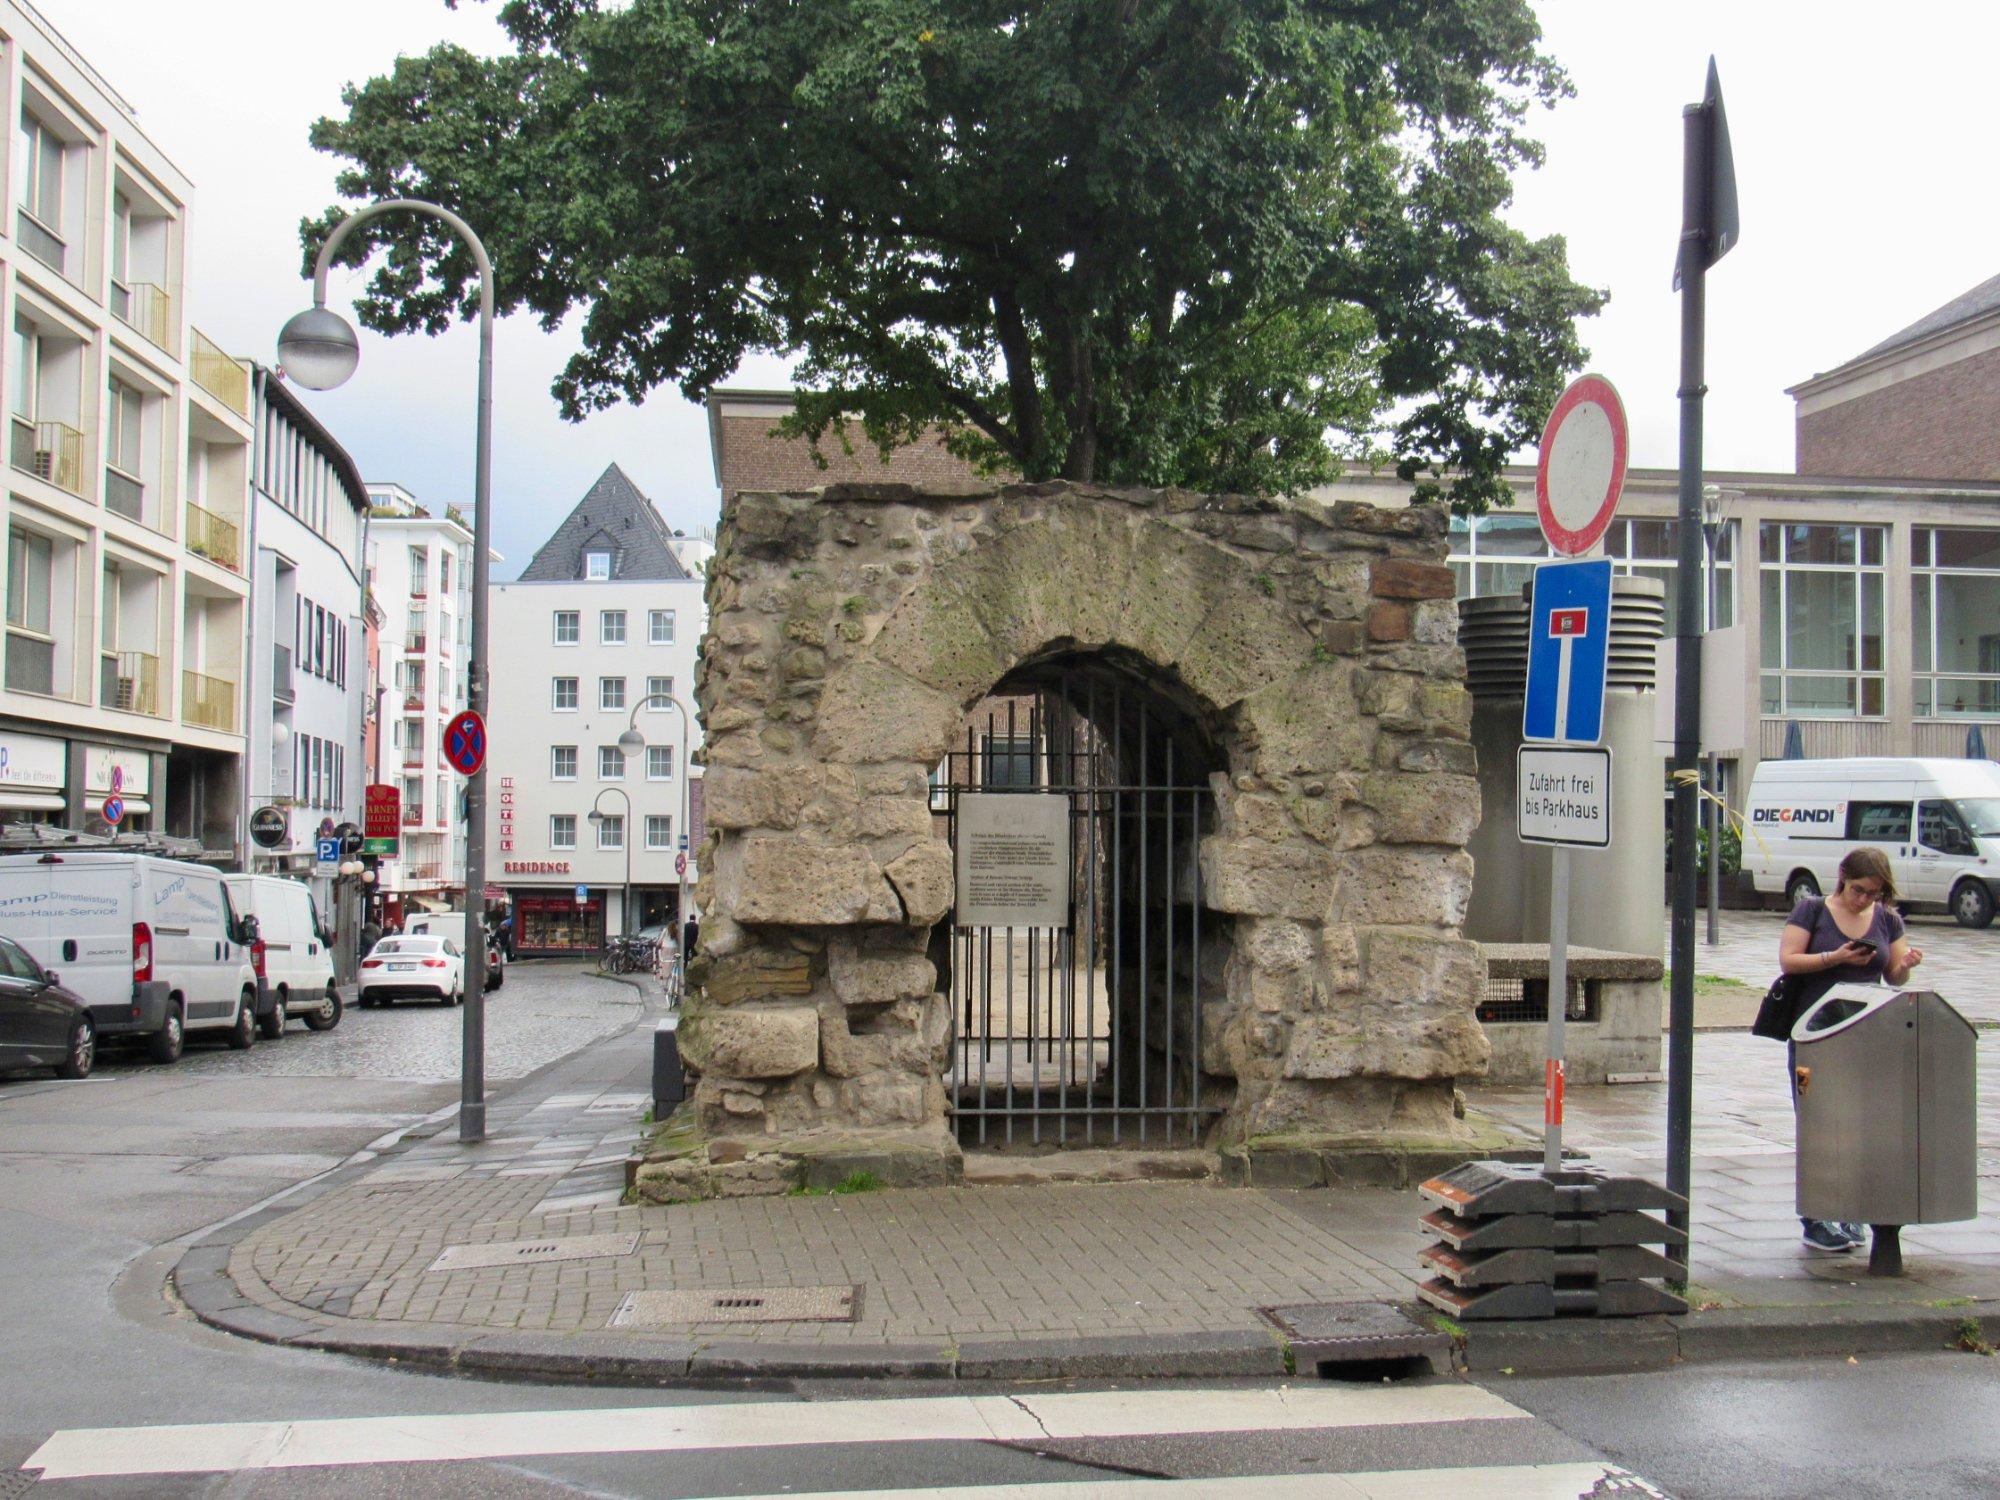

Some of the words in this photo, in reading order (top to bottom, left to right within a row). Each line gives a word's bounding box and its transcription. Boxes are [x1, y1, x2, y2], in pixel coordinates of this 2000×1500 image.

[1529, 773, 1565, 793] Zufahrt
[1571, 774, 1594, 794] frei
[367, 804, 397, 814] ARNEY
[501, 778, 511, 850] HOTEL
[1525, 797, 1539, 816] bis
[1542, 798, 1599, 820] Parkhaus
[1752, 807, 1835, 823] DIEGANDI
[253, 823, 283, 831] GUINNESS
[319, 842, 333, 860] P
[504, 861, 570, 874] RESIDENCE
[50, 891, 118, 906] Dienstleistung
